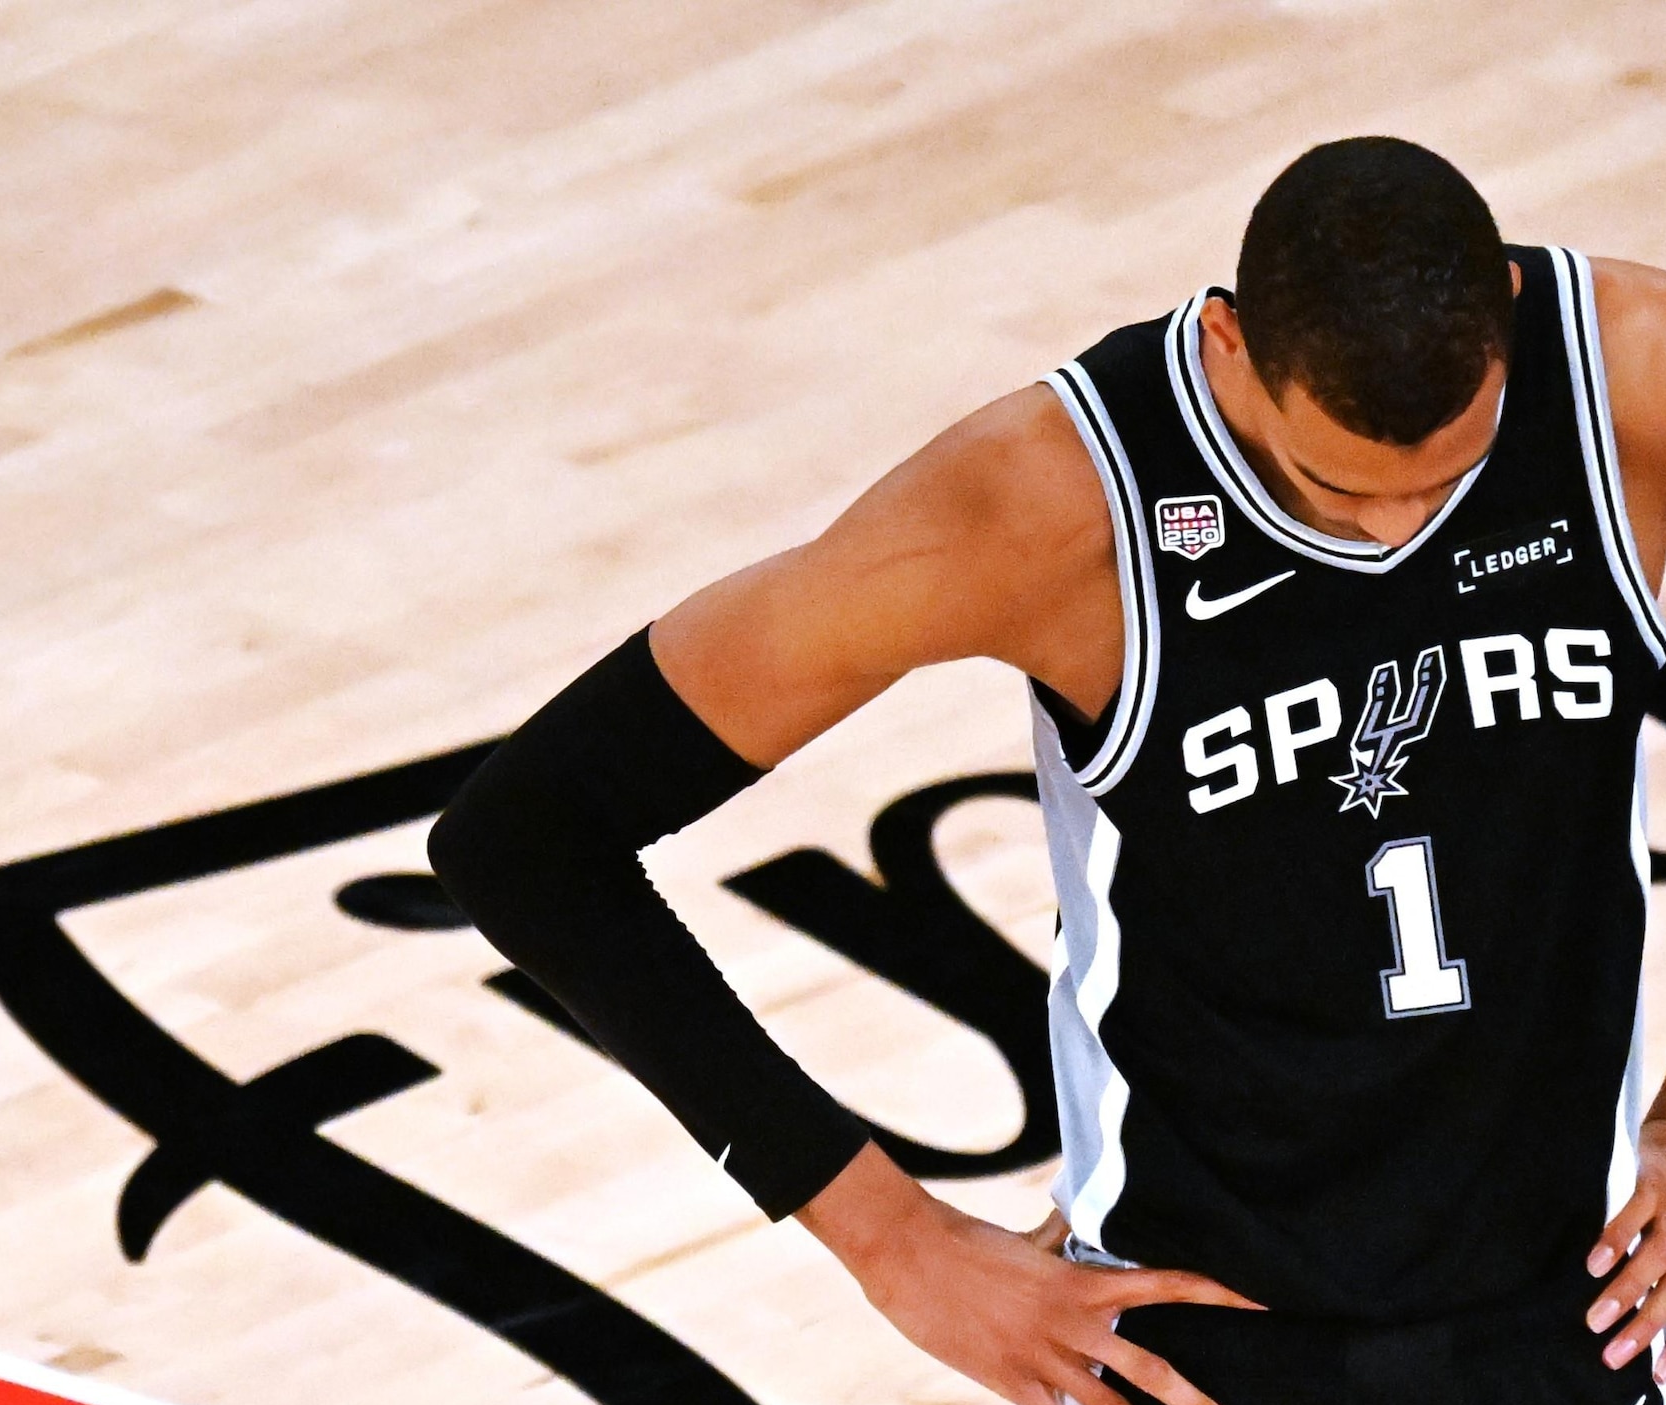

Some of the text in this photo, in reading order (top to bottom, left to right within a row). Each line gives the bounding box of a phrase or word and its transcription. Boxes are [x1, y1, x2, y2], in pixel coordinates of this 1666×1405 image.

[1164, 505, 1214, 521] USA
[1164, 528, 1220, 546] 250
[1470, 536, 1557, 578] LEDGER
[1364, 835, 1472, 1019] 1
